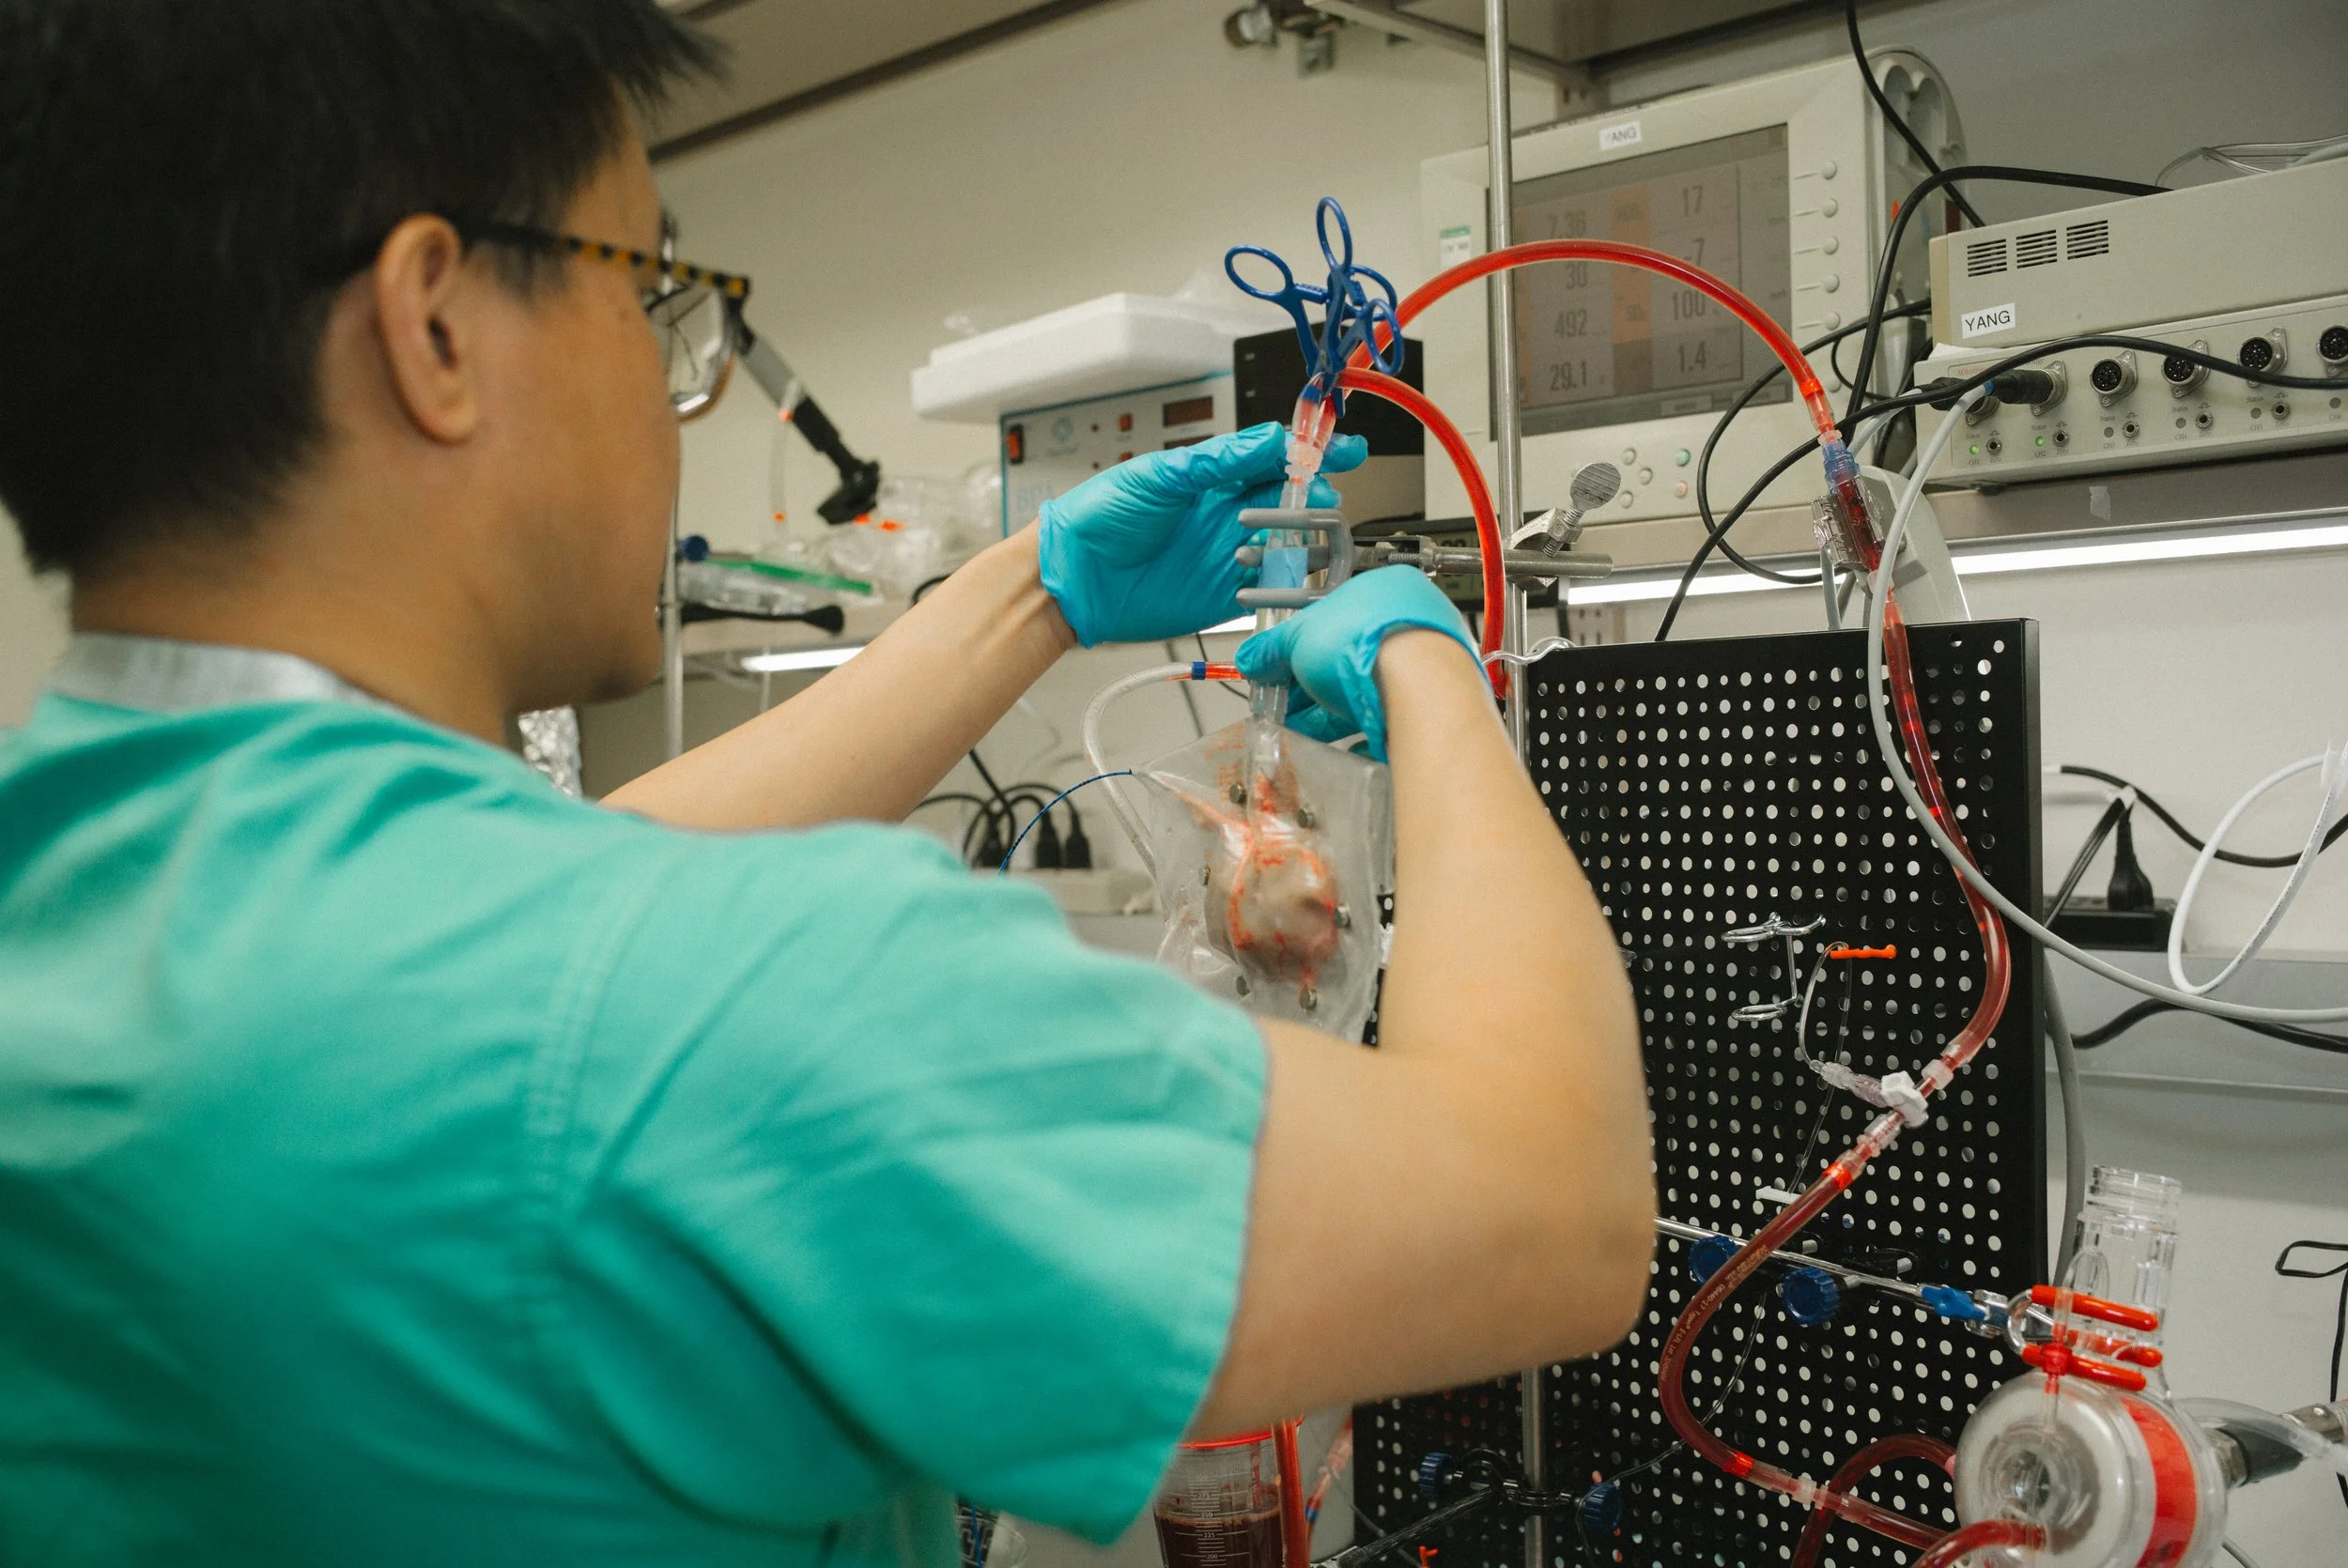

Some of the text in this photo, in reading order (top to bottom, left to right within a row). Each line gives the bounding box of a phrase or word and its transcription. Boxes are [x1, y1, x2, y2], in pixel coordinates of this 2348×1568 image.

[1682, 185, 1704, 216] 17
[1673, 290, 1706, 320] 100
[1554, 308, 1587, 339] 492
[1965, 310, 2011, 331] YANG
[1678, 341, 1707, 373] 1.4
[1549, 361, 1588, 391] 29.1
